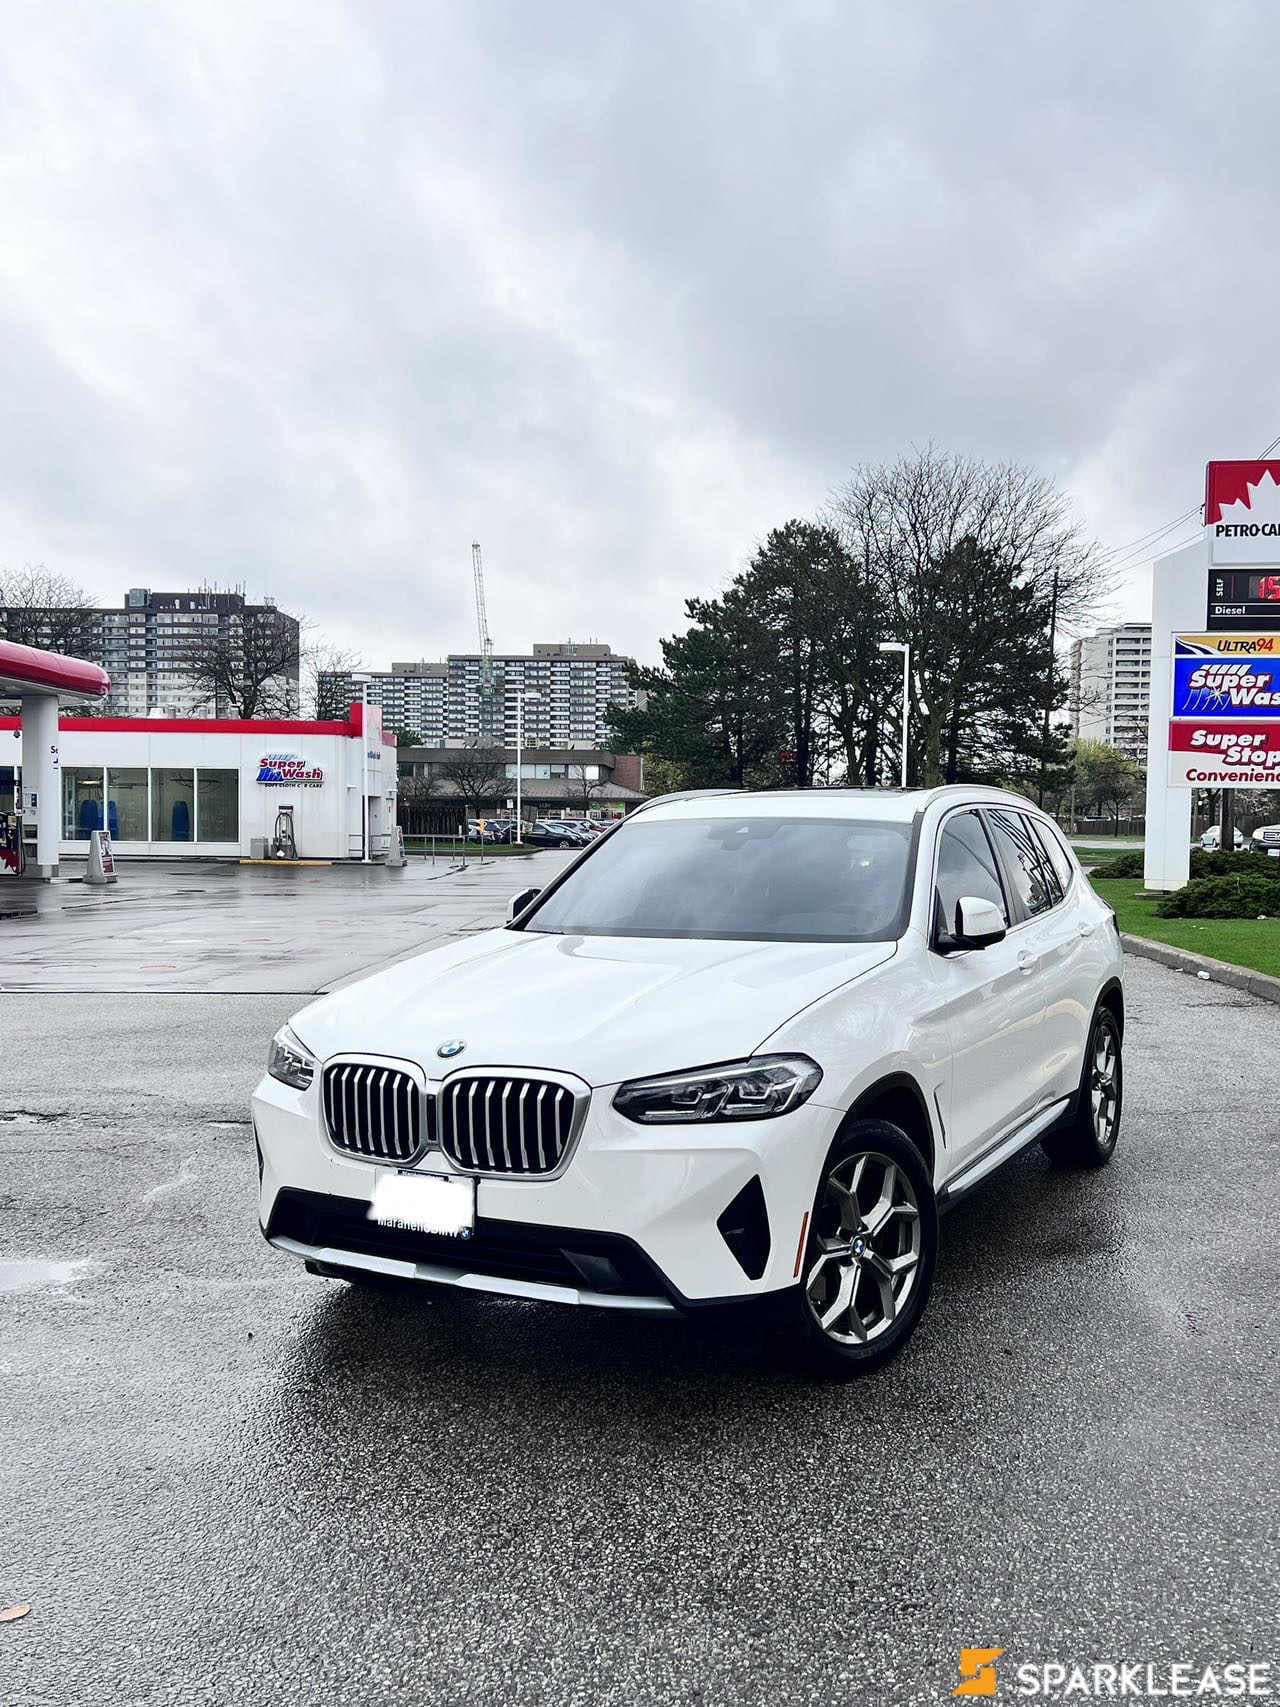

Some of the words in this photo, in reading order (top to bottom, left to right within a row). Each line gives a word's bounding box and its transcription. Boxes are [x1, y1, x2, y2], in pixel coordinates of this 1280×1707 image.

[1216, 578, 1224, 597] SELF
[1215, 606, 1246, 615] Diesel
[1189, 669, 1270, 692] Super
[1190, 730, 1266, 750] Super
[259, 758, 306, 770] Super
[1224, 746, 1280, 767] Stop
[282, 767, 322, 780] Wash
